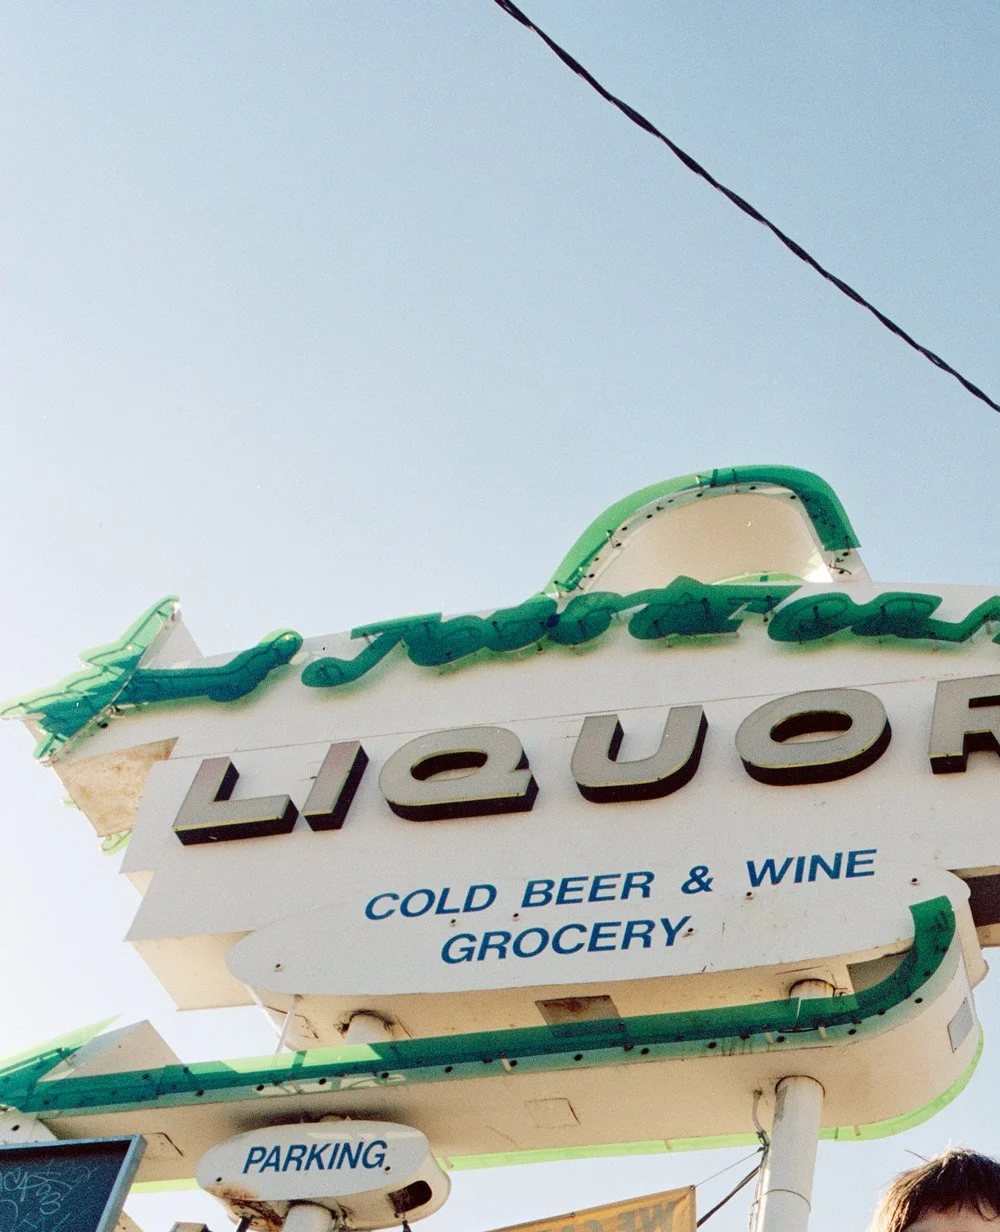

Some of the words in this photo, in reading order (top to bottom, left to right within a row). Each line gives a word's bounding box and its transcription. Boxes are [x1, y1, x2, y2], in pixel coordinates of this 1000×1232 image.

[365, 883, 497, 921] COLD
[520, 871, 655, 908] BEER
[681, 864, 714, 894] &
[746, 848, 878, 888] WINE
[440, 915, 693, 965] GROCERY
[242, 1140, 388, 1174] PARKING
